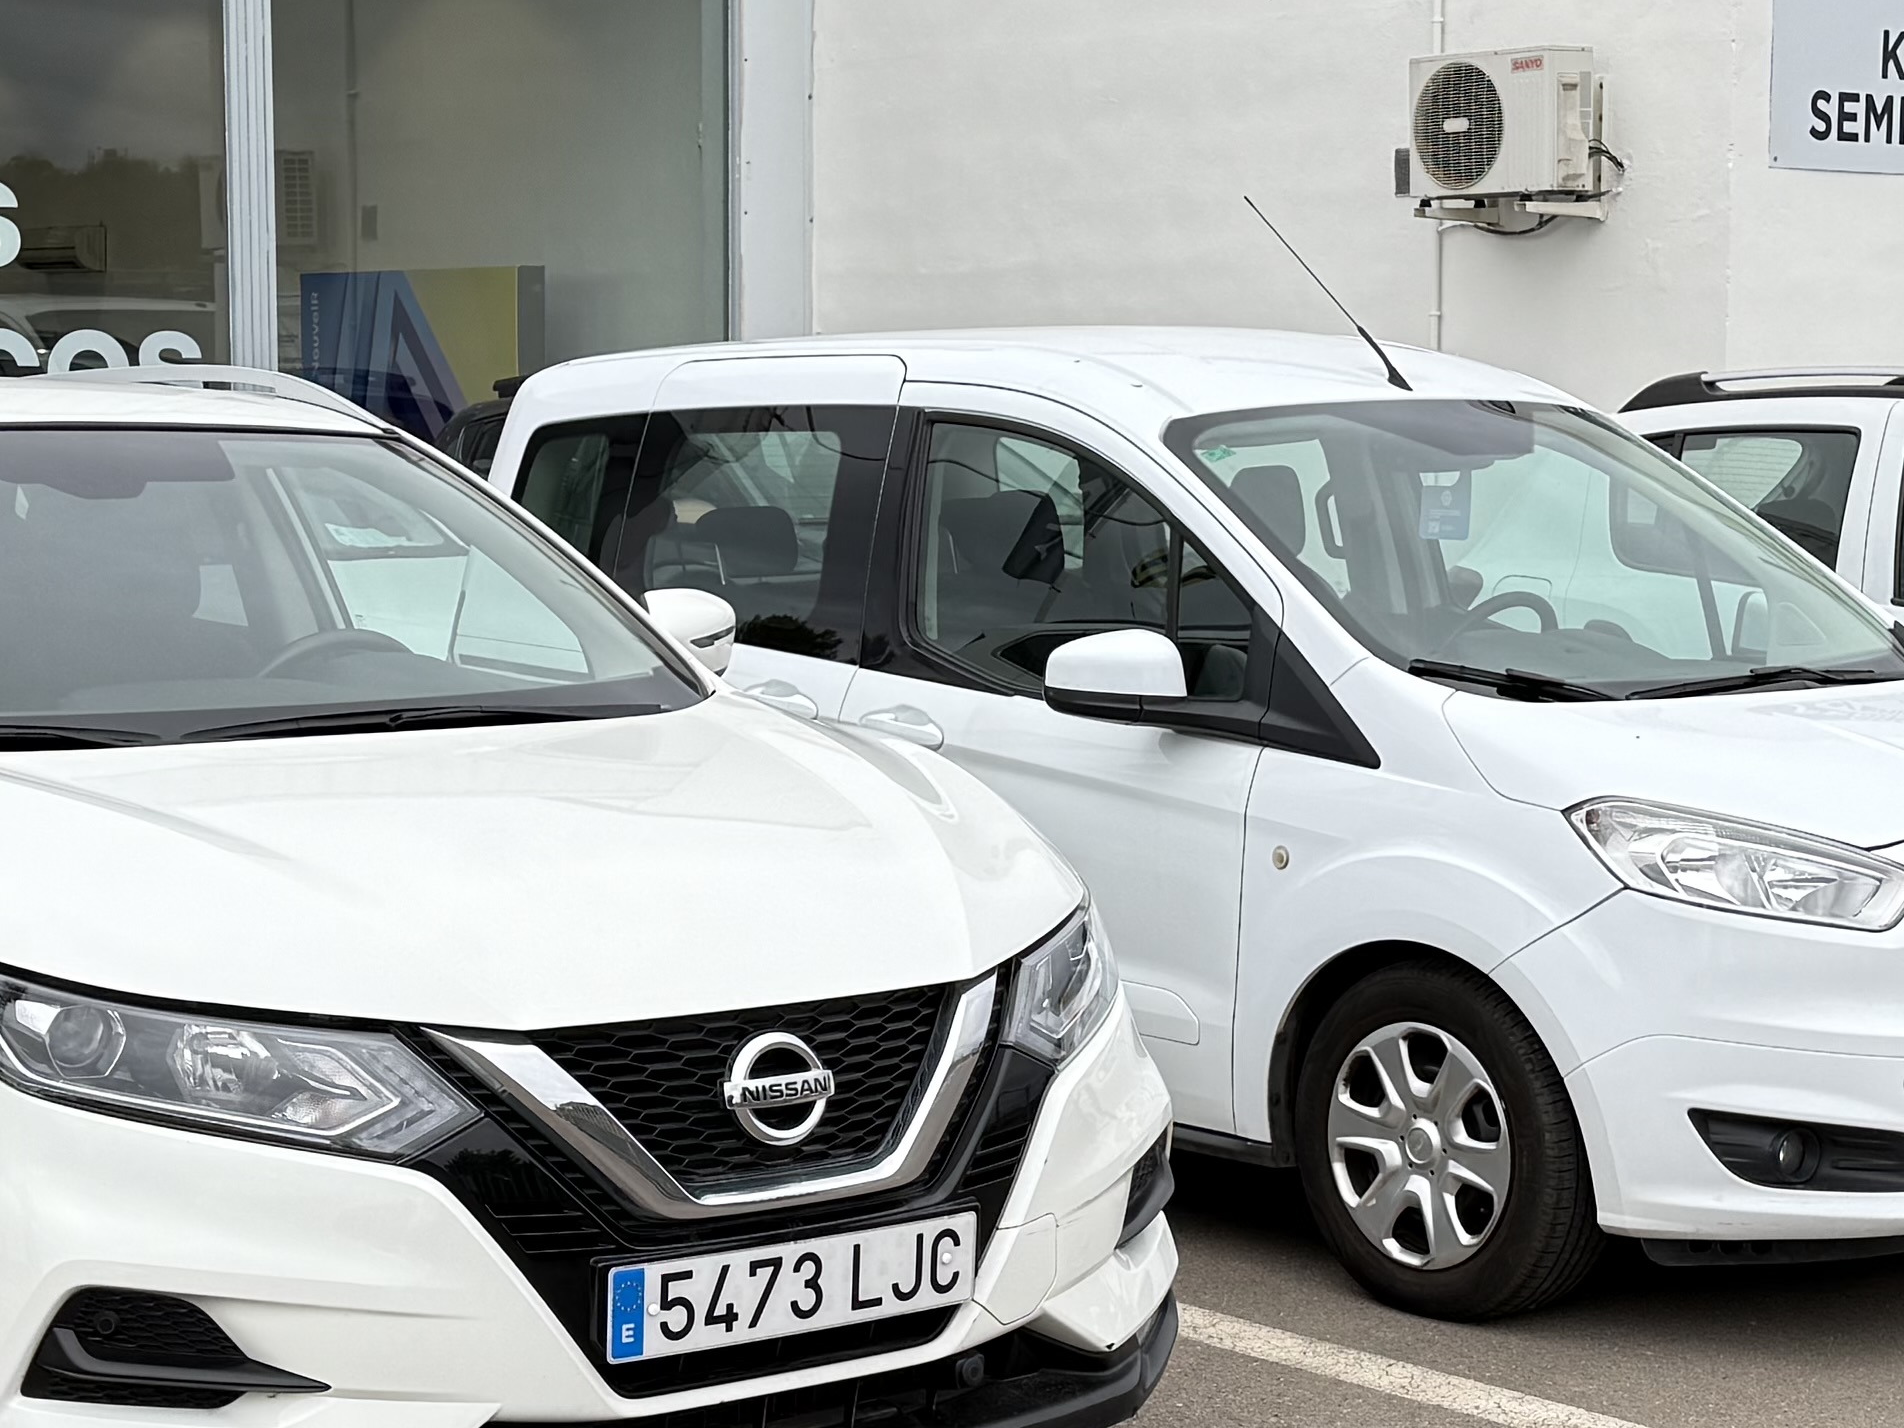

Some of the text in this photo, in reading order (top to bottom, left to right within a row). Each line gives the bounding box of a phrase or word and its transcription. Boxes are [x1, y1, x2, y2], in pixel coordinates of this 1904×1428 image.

[1512, 57, 1543, 71] SANYO
[740, 1074, 830, 1105] NISSAN
[658, 1228, 962, 1344] 5473 LJC
[621, 1323, 634, 1344] E
